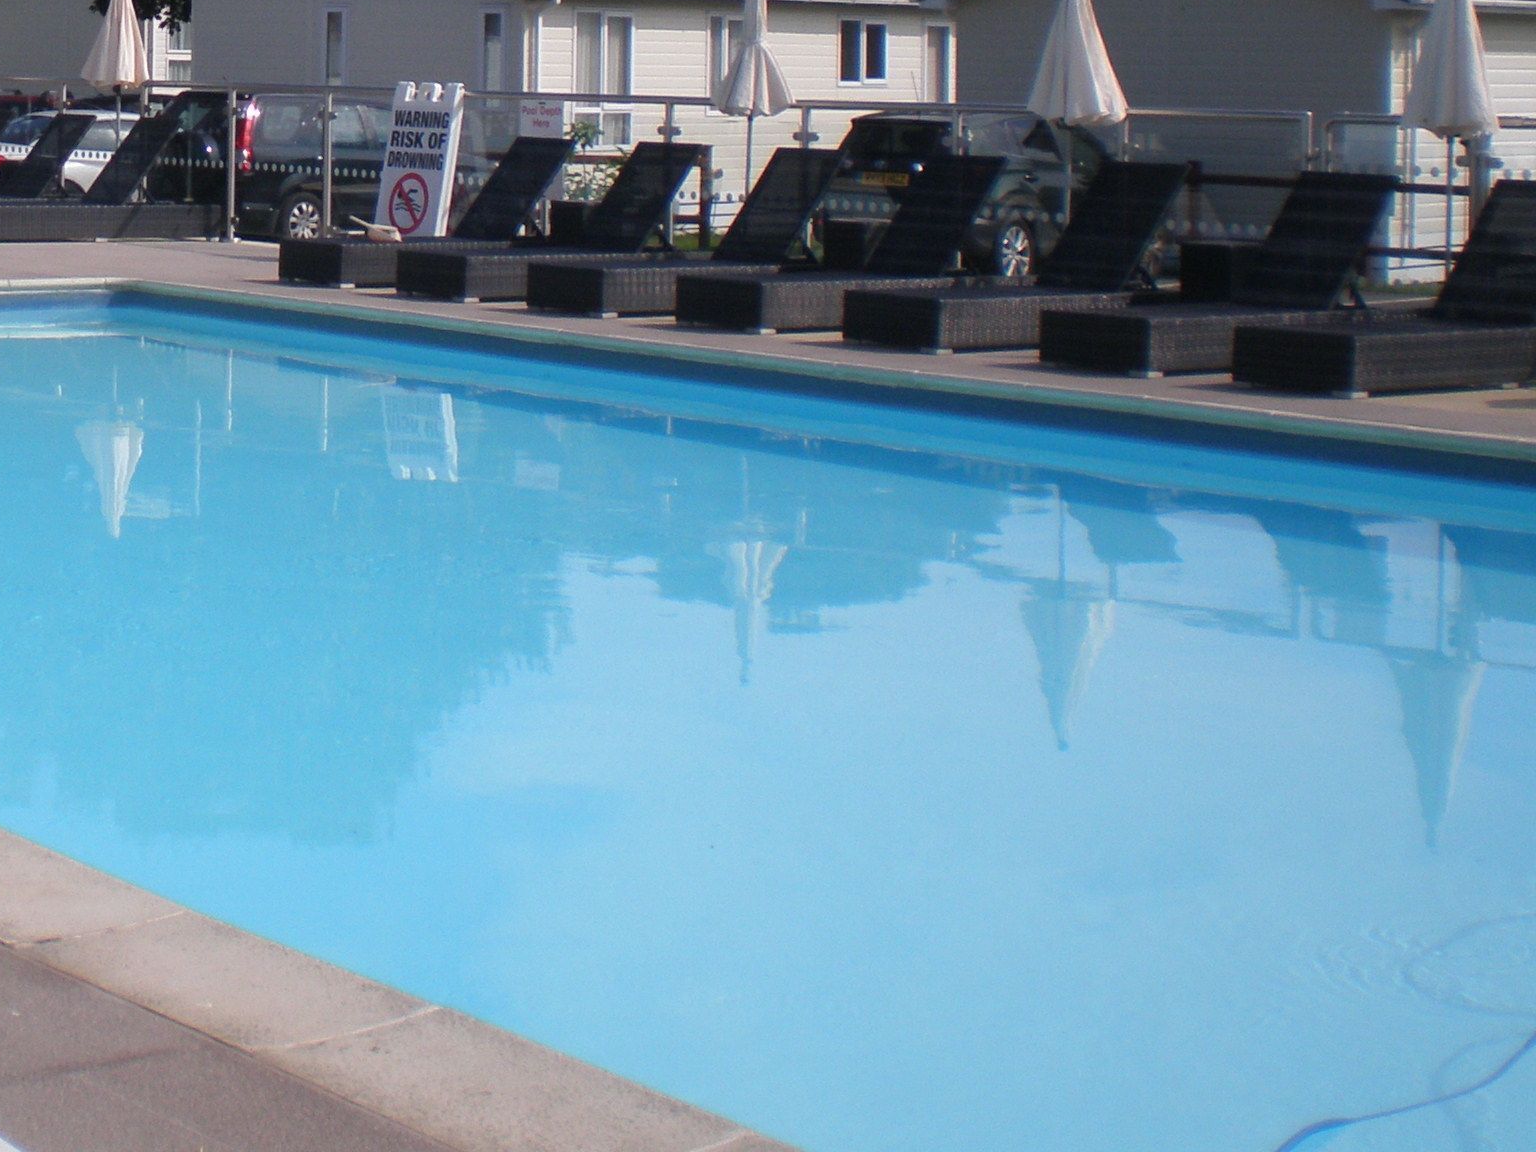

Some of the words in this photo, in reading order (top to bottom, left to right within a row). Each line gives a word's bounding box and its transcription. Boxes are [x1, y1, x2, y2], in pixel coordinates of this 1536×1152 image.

[394, 109, 450, 129] WARNING
[390, 130, 425, 148] RISK
[428, 132, 448, 149] OF
[386, 150, 444, 171] DROWNING
